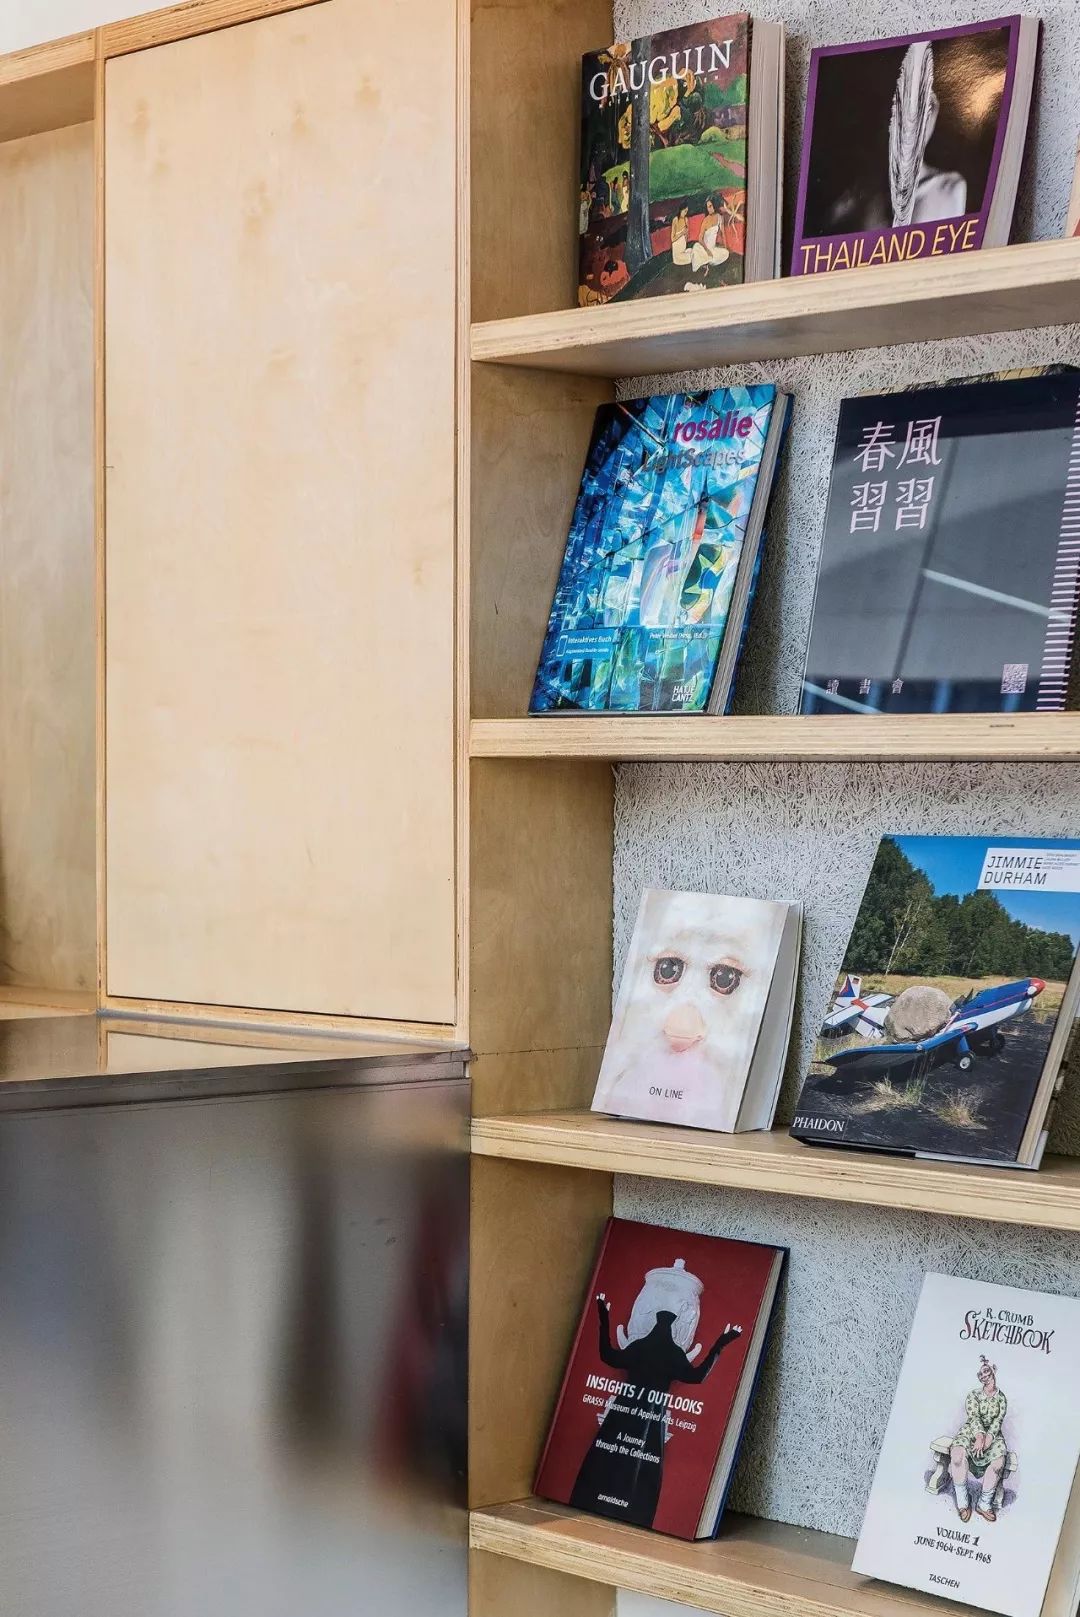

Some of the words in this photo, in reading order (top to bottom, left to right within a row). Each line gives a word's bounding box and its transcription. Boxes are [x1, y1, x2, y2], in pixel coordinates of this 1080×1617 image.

[589, 39, 734, 101] GAUGUIN
[800, 229, 926, 275] THAILAND
[931, 219, 980, 256] EYE
[672, 409, 753, 442] rosalie
[853, 415, 943, 472] 春風
[849, 476, 935, 534] 習習
[671, 693, 694, 702] CANTZ
[672, 685, 697, 694] HATJE
[987, 856, 1044, 870] JIMMIE
[983, 871, 1048, 885] DURHAM
[649, 1086, 662, 1096] ON
[664, 1089, 683, 1100] LINE
[792, 1116, 845, 1132] PHAIDON
[986, 1307, 997, 1320] R.
[998, 1309, 1034, 1327] CRUMB
[959, 1310, 1055, 1355] SKETCHBOOK
[585, 1374, 637, 1398] INSIGHTS
[637, 1387, 646, 1400] /
[647, 1389, 704, 1415] OUTLOOKS
[582, 1393, 604, 1407] GRASSI
[604, 1400, 631, 1414] Museum
[630, 1406, 639, 1416] of
[638, 1408, 661, 1422] Applied
[660, 1413, 675, 1425] Arts
[675, 1417, 697, 1433] Leipzig
[595, 1439, 618, 1453] through
[618, 1445, 630, 1455] the
[630, 1447, 660, 1464] Collections
[616, 1431, 622, 1441] A
[622, 1433, 646, 1449] Journey
[936, 1526, 971, 1544] VOLUME
[972, 1536, 980, 1547] 1
[913, 1535, 936, 1548] JUNE
[975, 1551, 992, 1564] 1968
[929, 1573, 960, 1588] TASCHEN
